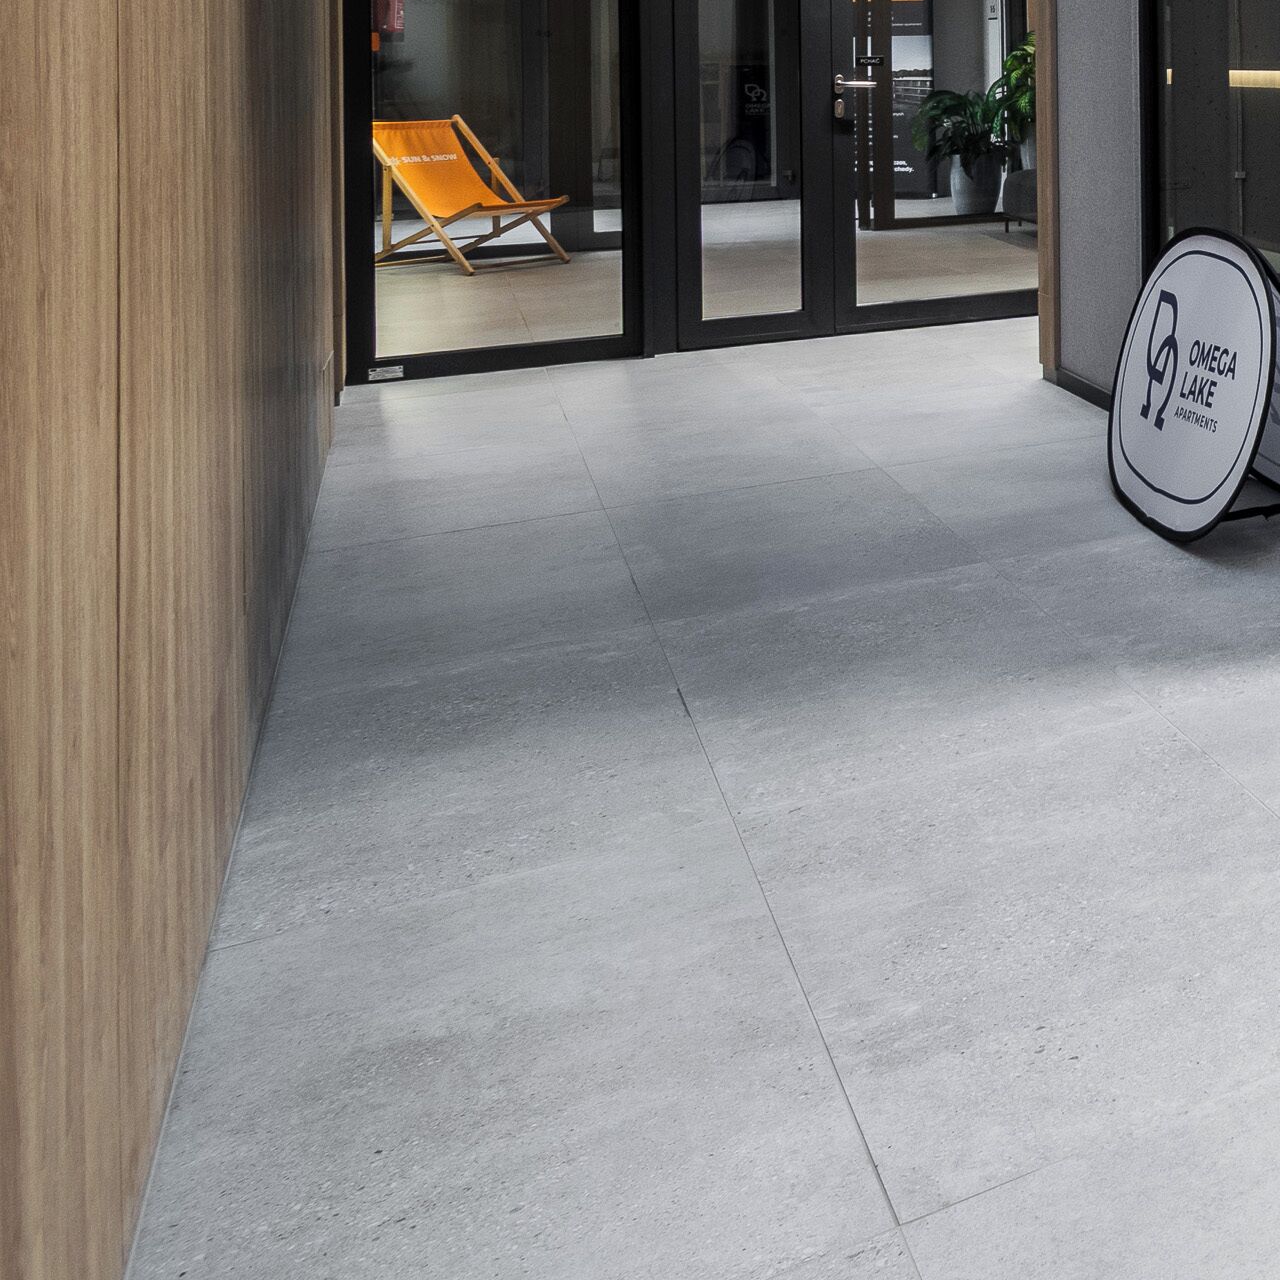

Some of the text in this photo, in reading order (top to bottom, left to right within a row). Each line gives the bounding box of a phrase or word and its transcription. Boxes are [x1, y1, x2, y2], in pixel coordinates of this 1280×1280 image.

[431, 153, 458, 161] SNOW
[1189, 340, 1237, 380] OMEGA
[1179, 371, 1218, 409] LAKE
[1174, 406, 1218, 433] APARTMENTS
